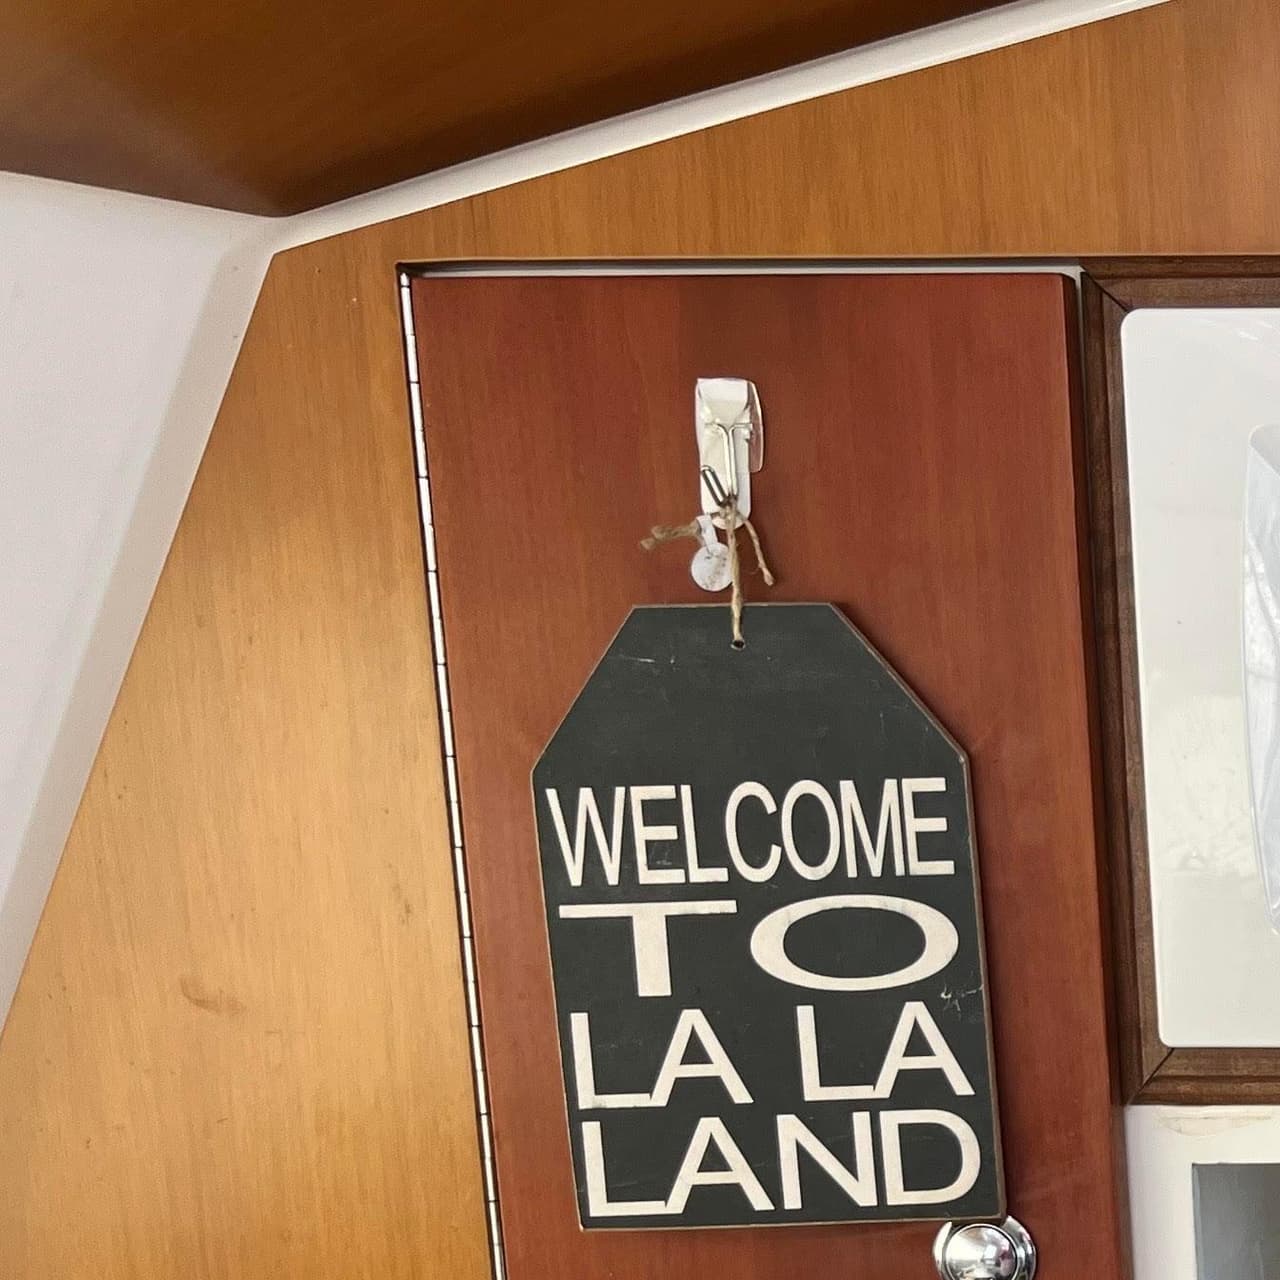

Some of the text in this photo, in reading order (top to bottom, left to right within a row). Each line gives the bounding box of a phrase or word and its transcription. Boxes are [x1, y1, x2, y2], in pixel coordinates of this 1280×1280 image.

[545, 777, 955, 886] WELCOME
[558, 893, 958, 997] TO
[570, 1001, 975, 1110] LA LA
[582, 1109, 981, 1218] LAND
